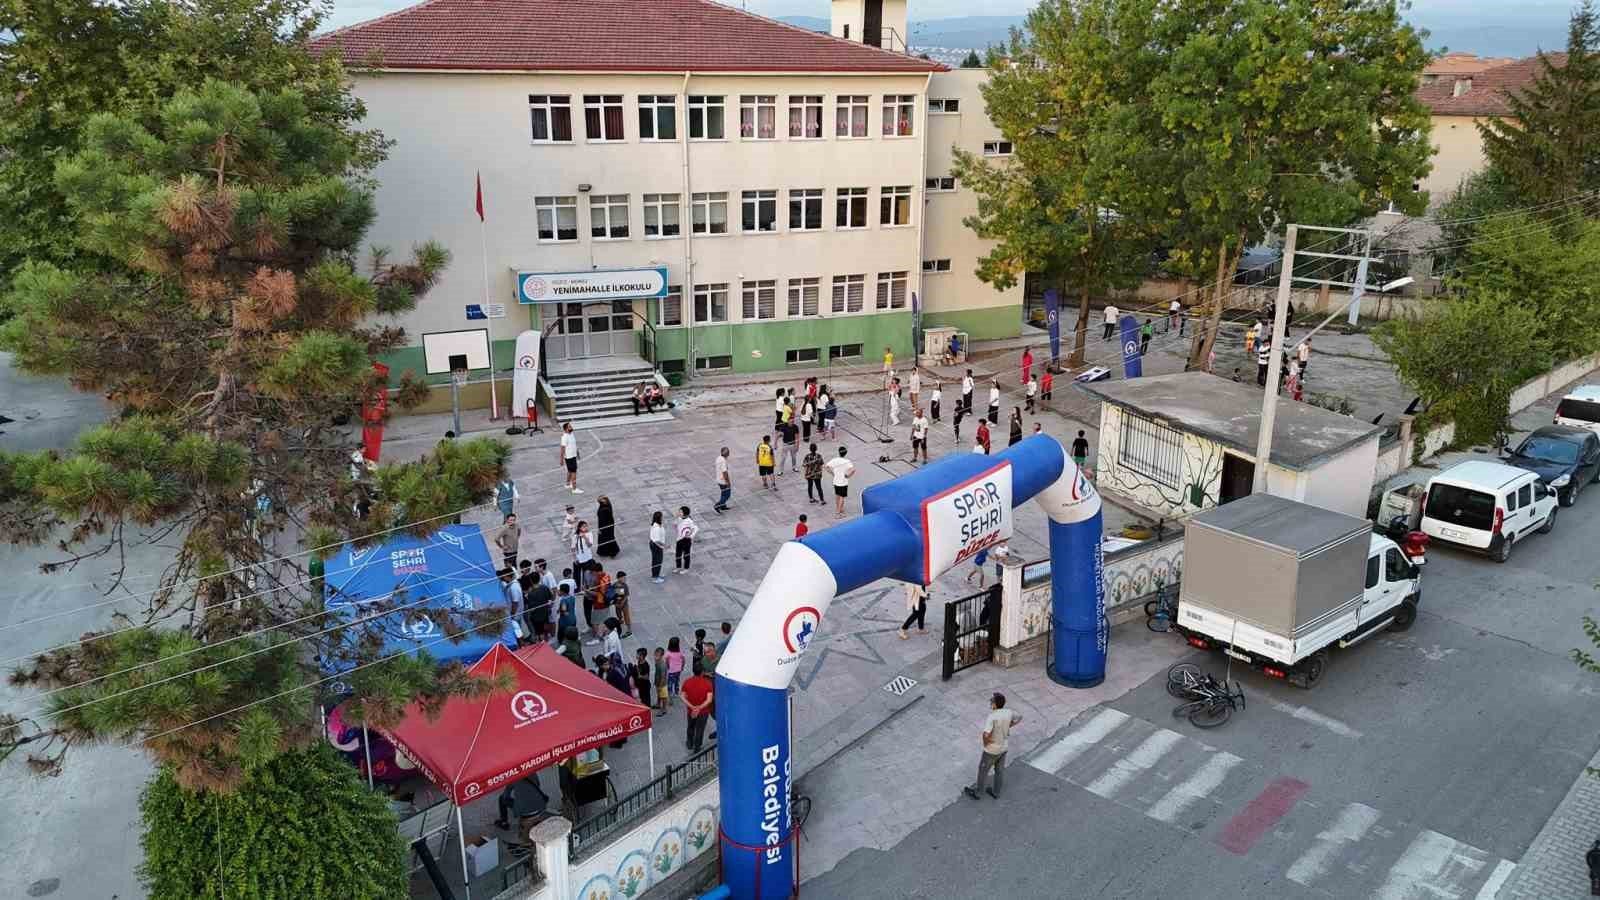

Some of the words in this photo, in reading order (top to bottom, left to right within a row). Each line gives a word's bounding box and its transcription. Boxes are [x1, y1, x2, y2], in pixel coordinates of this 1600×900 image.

[553, 285, 611, 295] YENİMAHALLE
[612, 282, 652, 292] İLKOKULU
[953, 482, 1001, 519] SPOR
[487, 767, 519, 786] SOSYAL
[520, 752, 552, 771] YARDIM
[761, 743, 783, 865] Belediyesi
